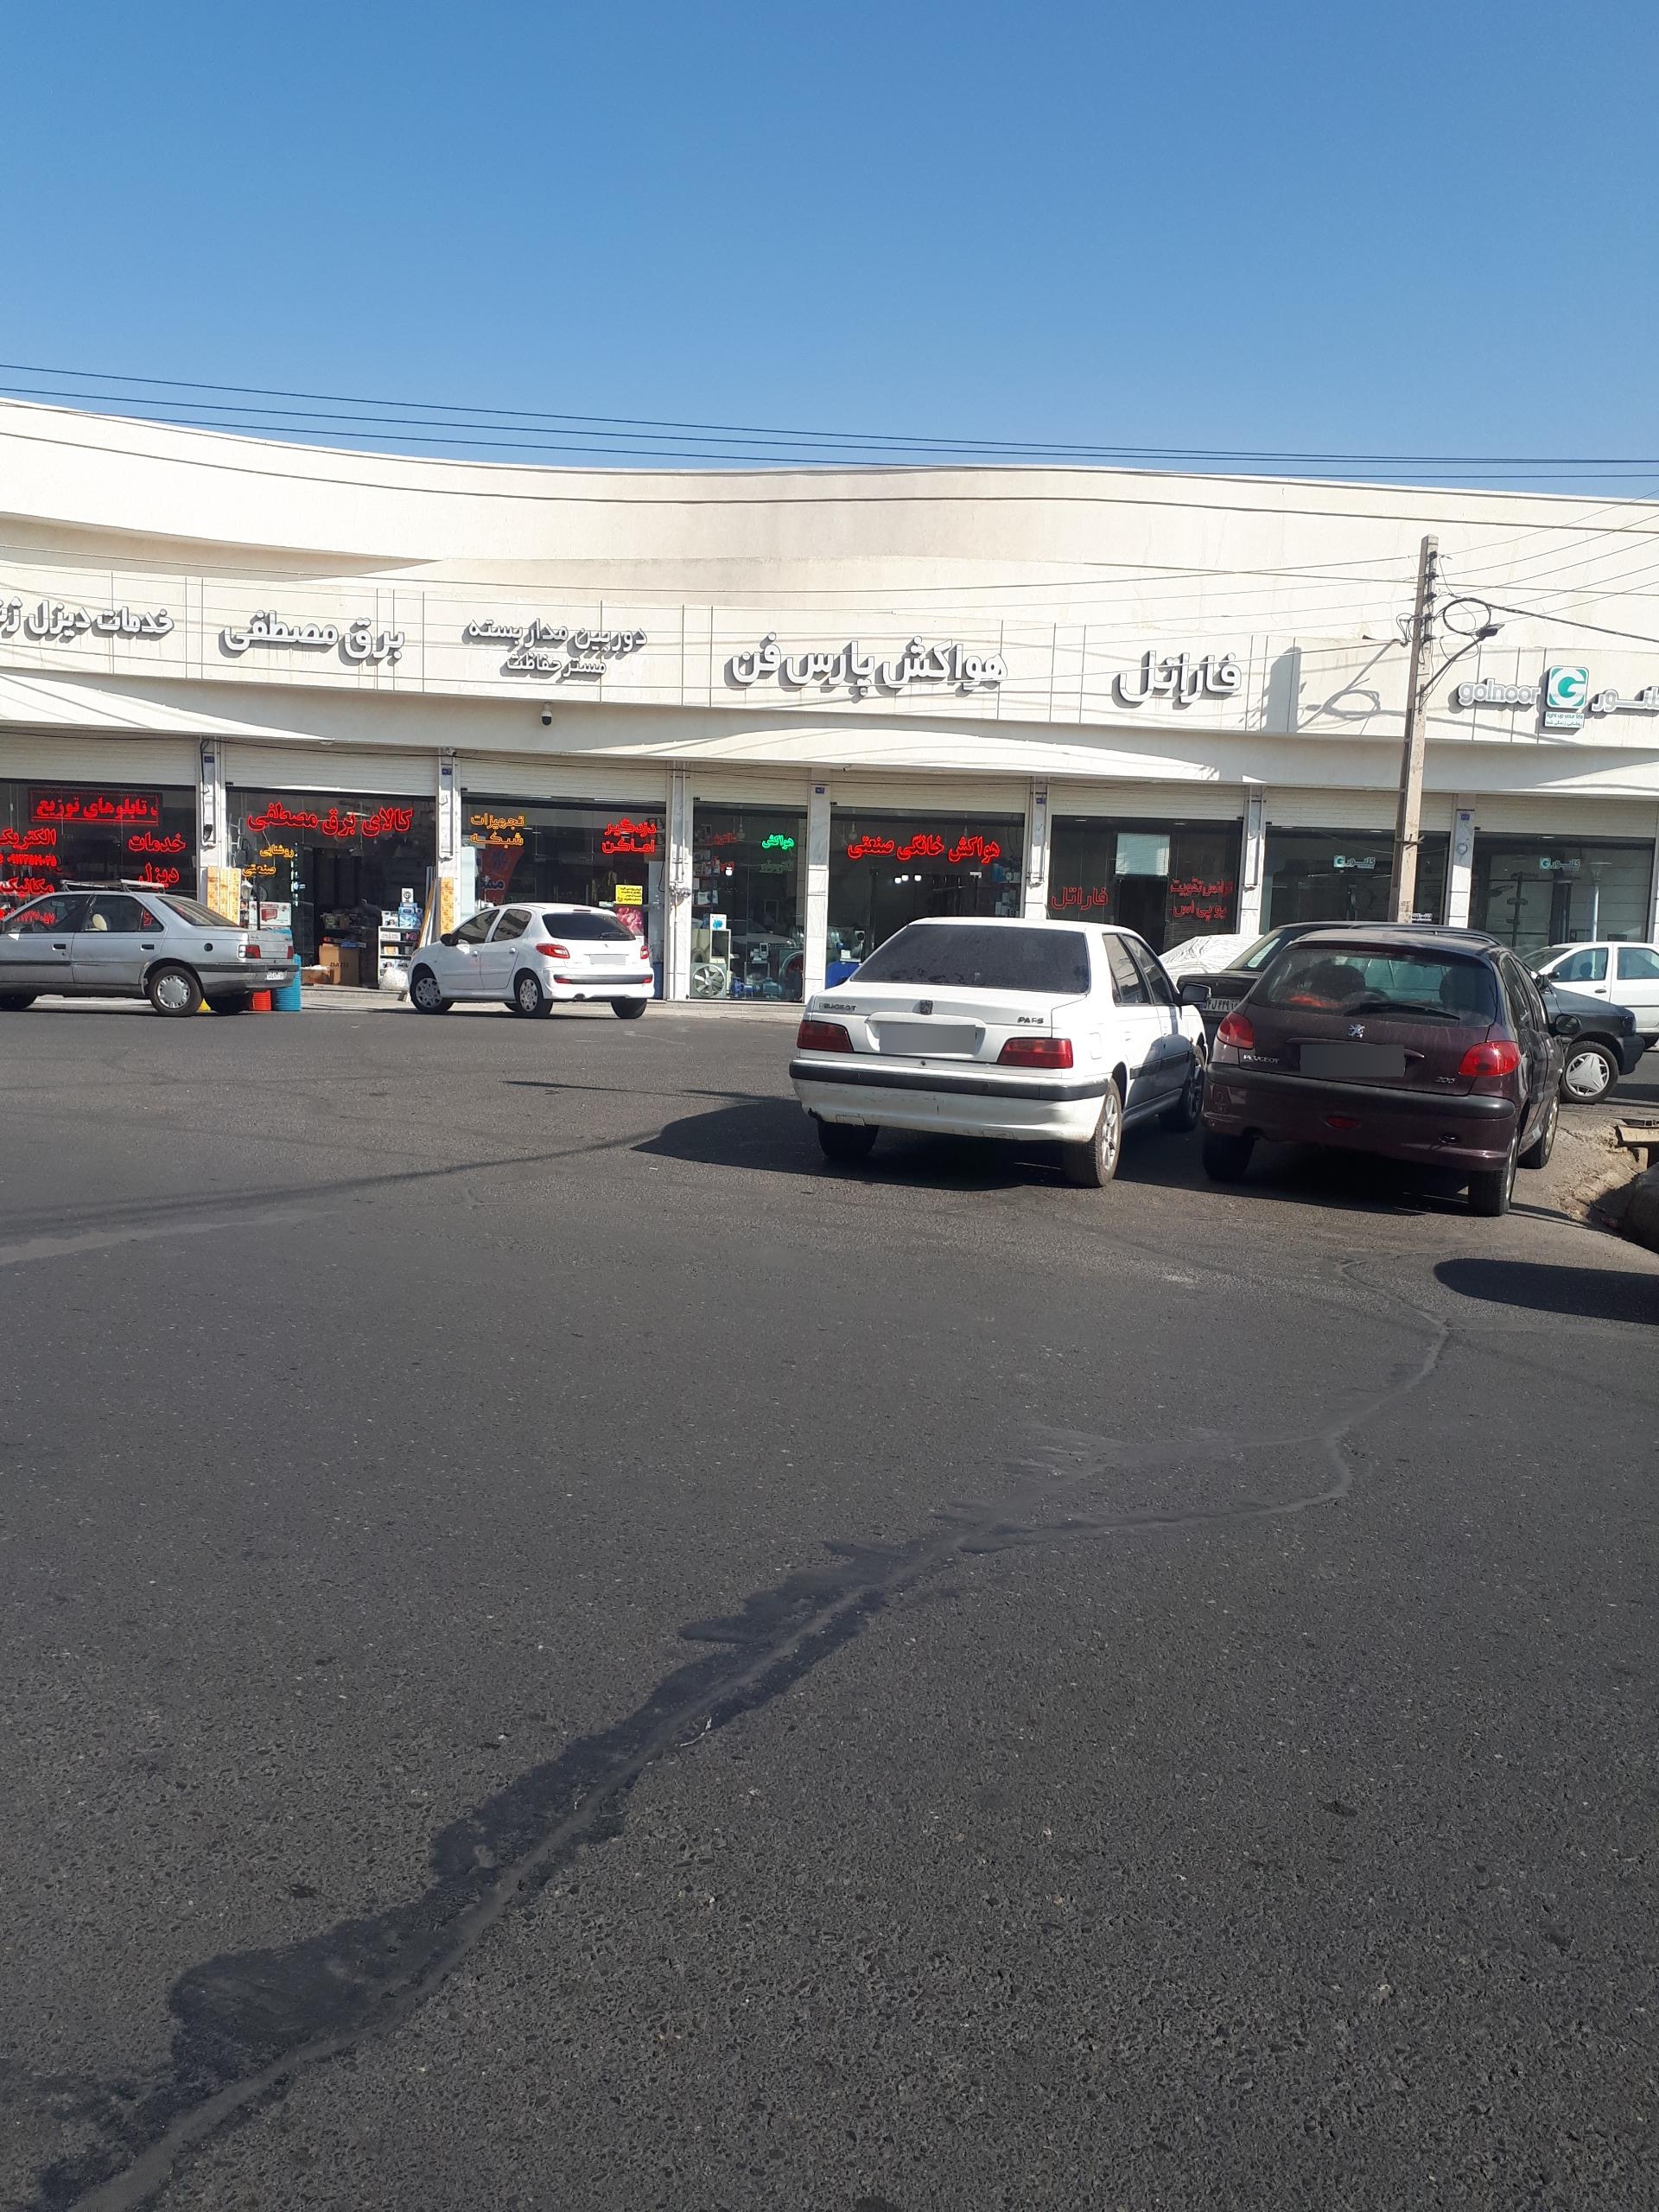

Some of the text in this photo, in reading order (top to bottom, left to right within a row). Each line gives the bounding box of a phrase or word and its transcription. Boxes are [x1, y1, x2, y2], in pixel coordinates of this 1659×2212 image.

[29, 600, 92, 637] دیزل
[97, 606, 174, 634] خدمات
[225, 610, 405, 659] برق مصطفی
[469, 618, 647, 652] دوربین مدار بسته
[507, 652, 607, 677] مستر حفاظت
[732, 632, 1007, 696] هواکش پارس فن
[1120, 651, 1242, 703] فاراتل
[1458, 678, 1541, 706] golnoor
[83, 796, 148, 819] تابلوهای
[247, 802, 413, 836] کالای برق مصطفی
[470, 812, 524, 830] تجهیزات
[604, 817, 657, 837] دزدگیر
[0, 828, 56, 850] الکتریک
[128, 831, 186, 853] خدمات
[260, 843, 295, 857] روشنایی
[470, 831, 524, 849] شبکه
[601, 837, 655, 854] اماکن
[761, 834, 794, 849] هواکش
[848, 835, 1001, 863] هواکش خانگی صنعتی
[139, 862, 180, 888] دیزل
[1170, 877, 1203, 897] تقویت
[1, 877, 54, 898] مکانیک
[1051, 886, 1109, 911] فاراتل
[1173, 899, 1227, 923] یو پی اس
[818, 1002, 856, 1011] PEUGEOT
